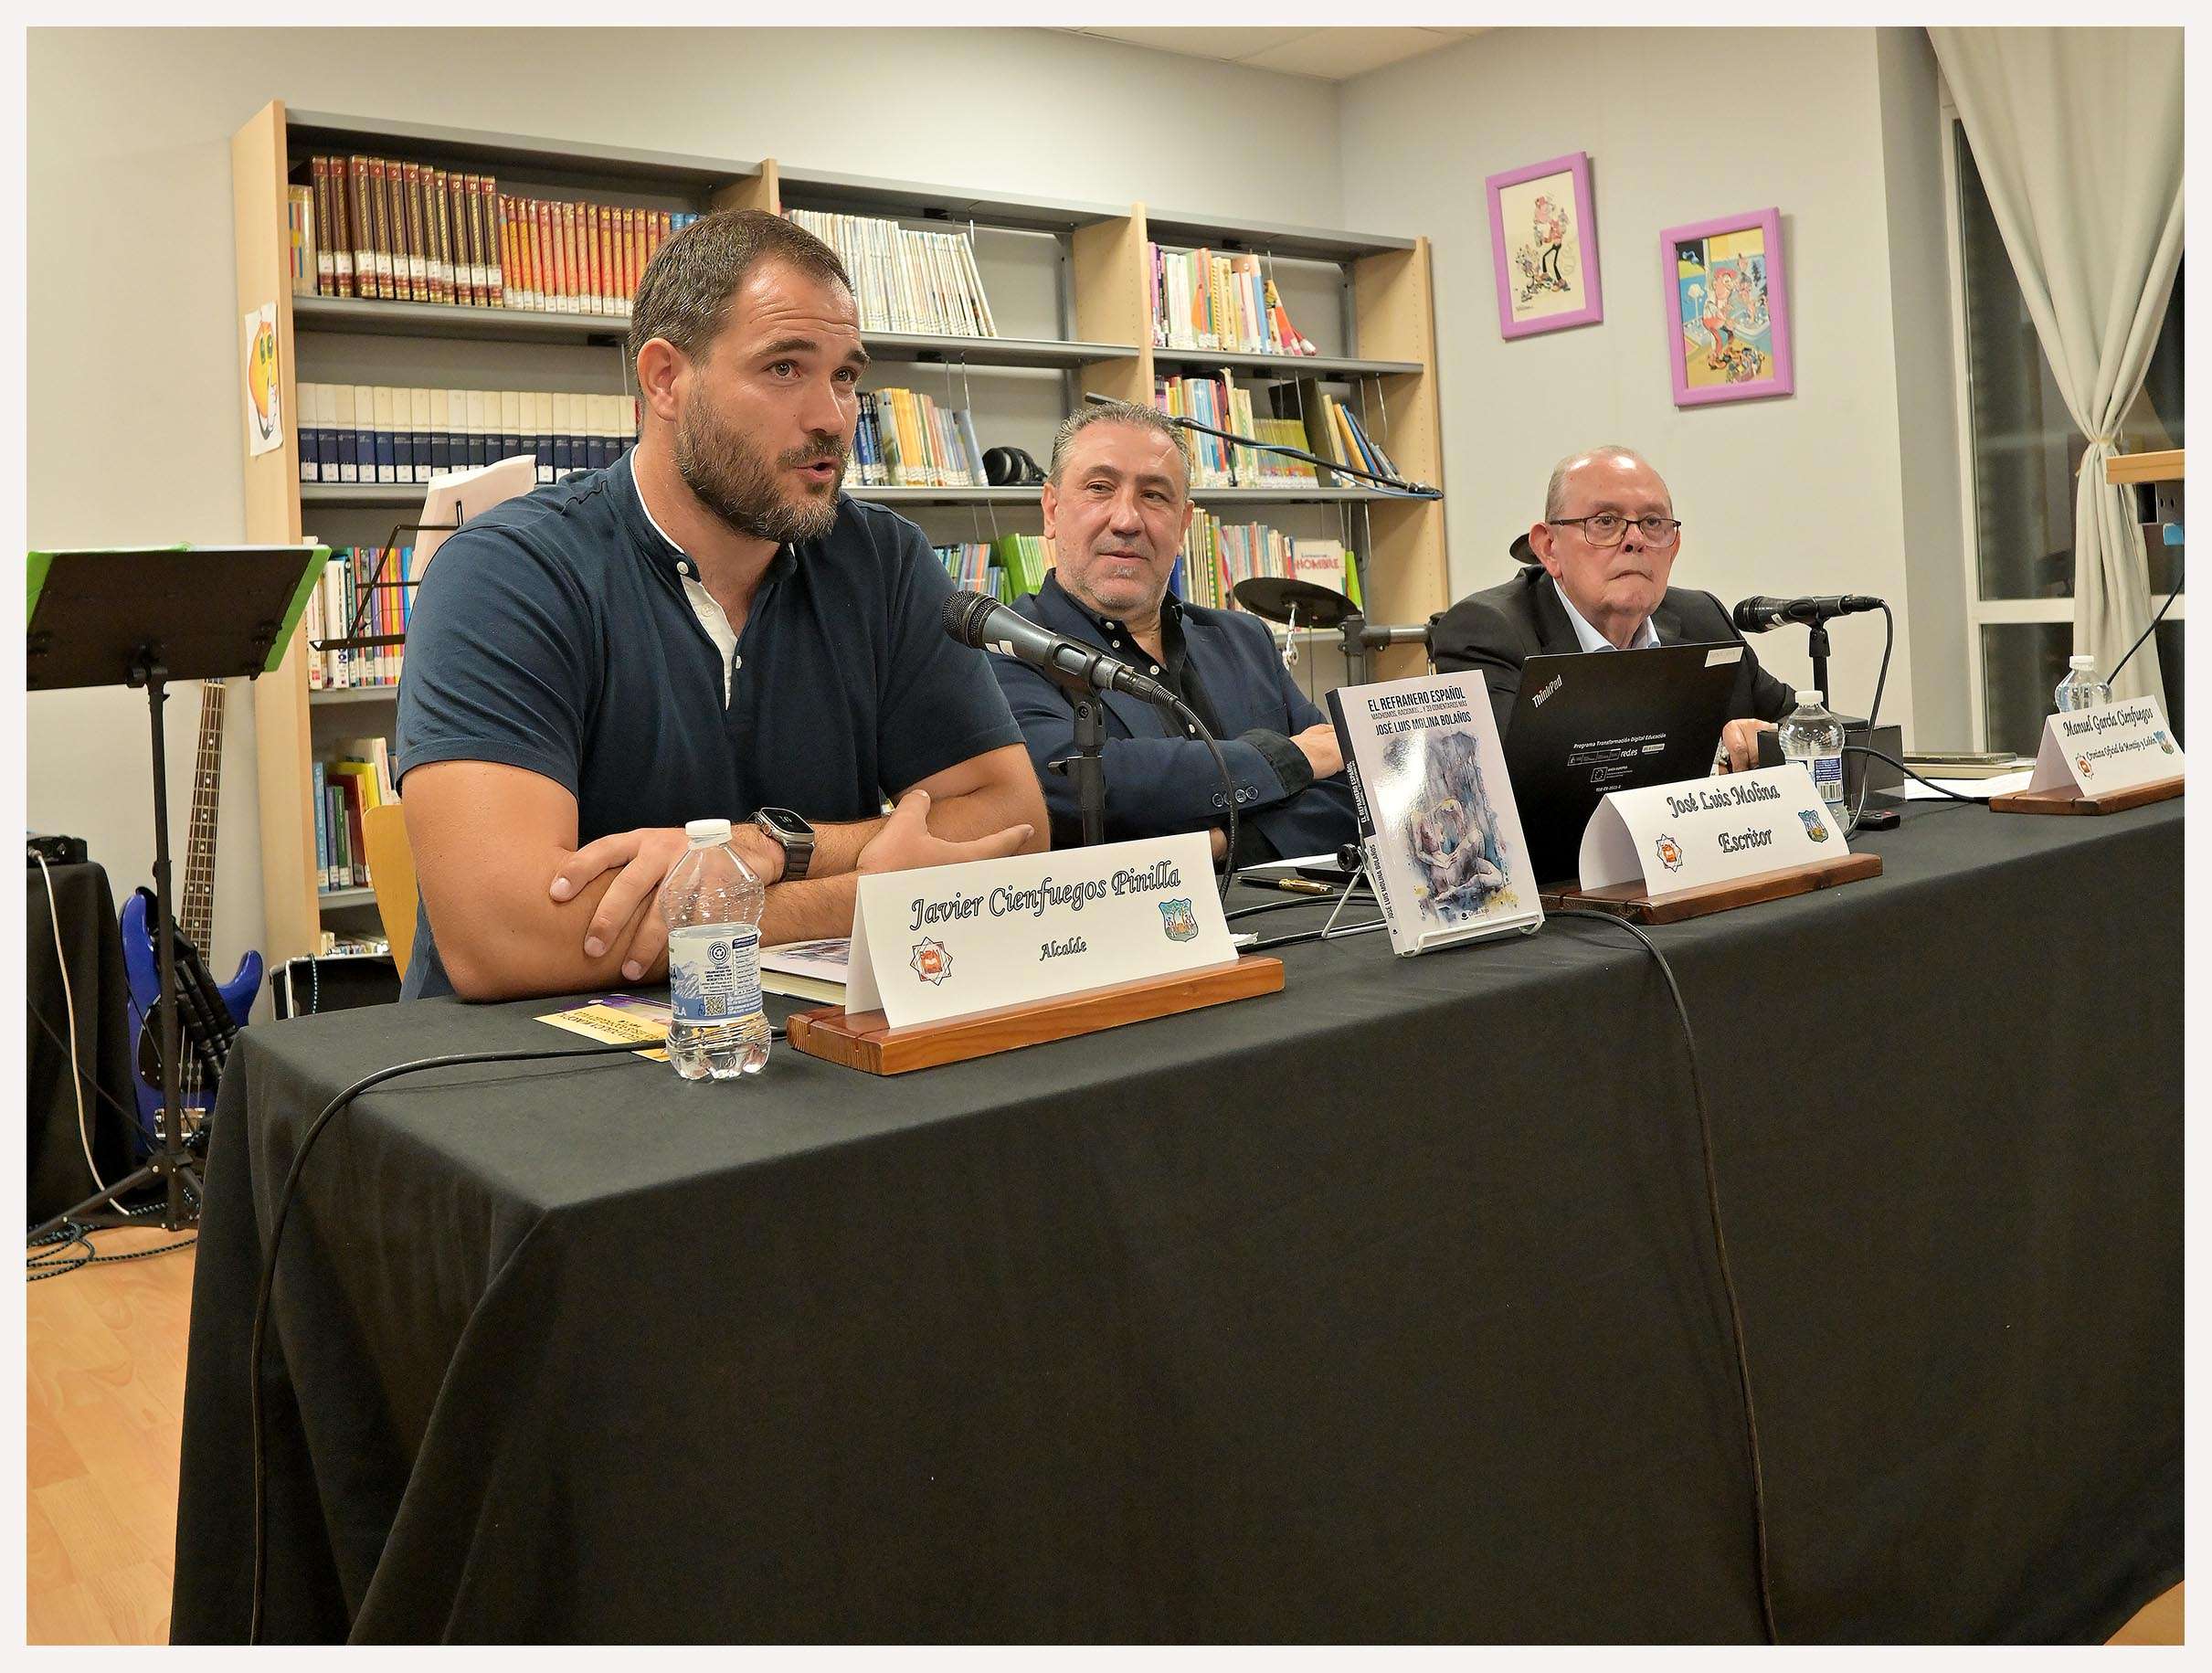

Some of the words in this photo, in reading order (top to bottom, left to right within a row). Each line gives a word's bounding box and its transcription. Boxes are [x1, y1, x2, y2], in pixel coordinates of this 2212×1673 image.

[1368, 699, 1380, 712] EL
[1380, 691, 1429, 711] REFRANERO
[1430, 685, 1466, 703] ESPAÑOL
[1531, 674, 1562, 707] ThinkPad
[1376, 720, 1393, 736] JOSÉ
[1394, 720, 1411, 733] LUIS
[1412, 715, 1440, 729] MOLINA
[1440, 711, 1472, 725] BOLAÑOS
[2063, 715, 2094, 736] Manuel
[2117, 705, 2154, 727] Cienfuegos
[1667, 793, 1699, 818] José
[1699, 789, 1732, 810] Luis
[1730, 781, 1781, 805] Molina
[1718, 828, 1773, 853] Escritor
[1375, 870, 1386, 892] MOLINA
[910, 893, 984, 930] Javier
[989, 877, 1106, 917] Cienfuegos
[1111, 861, 1181, 895] Pinilla
[1381, 892, 1390, 905] LUIS
[1040, 937, 1087, 961] Alcalde
